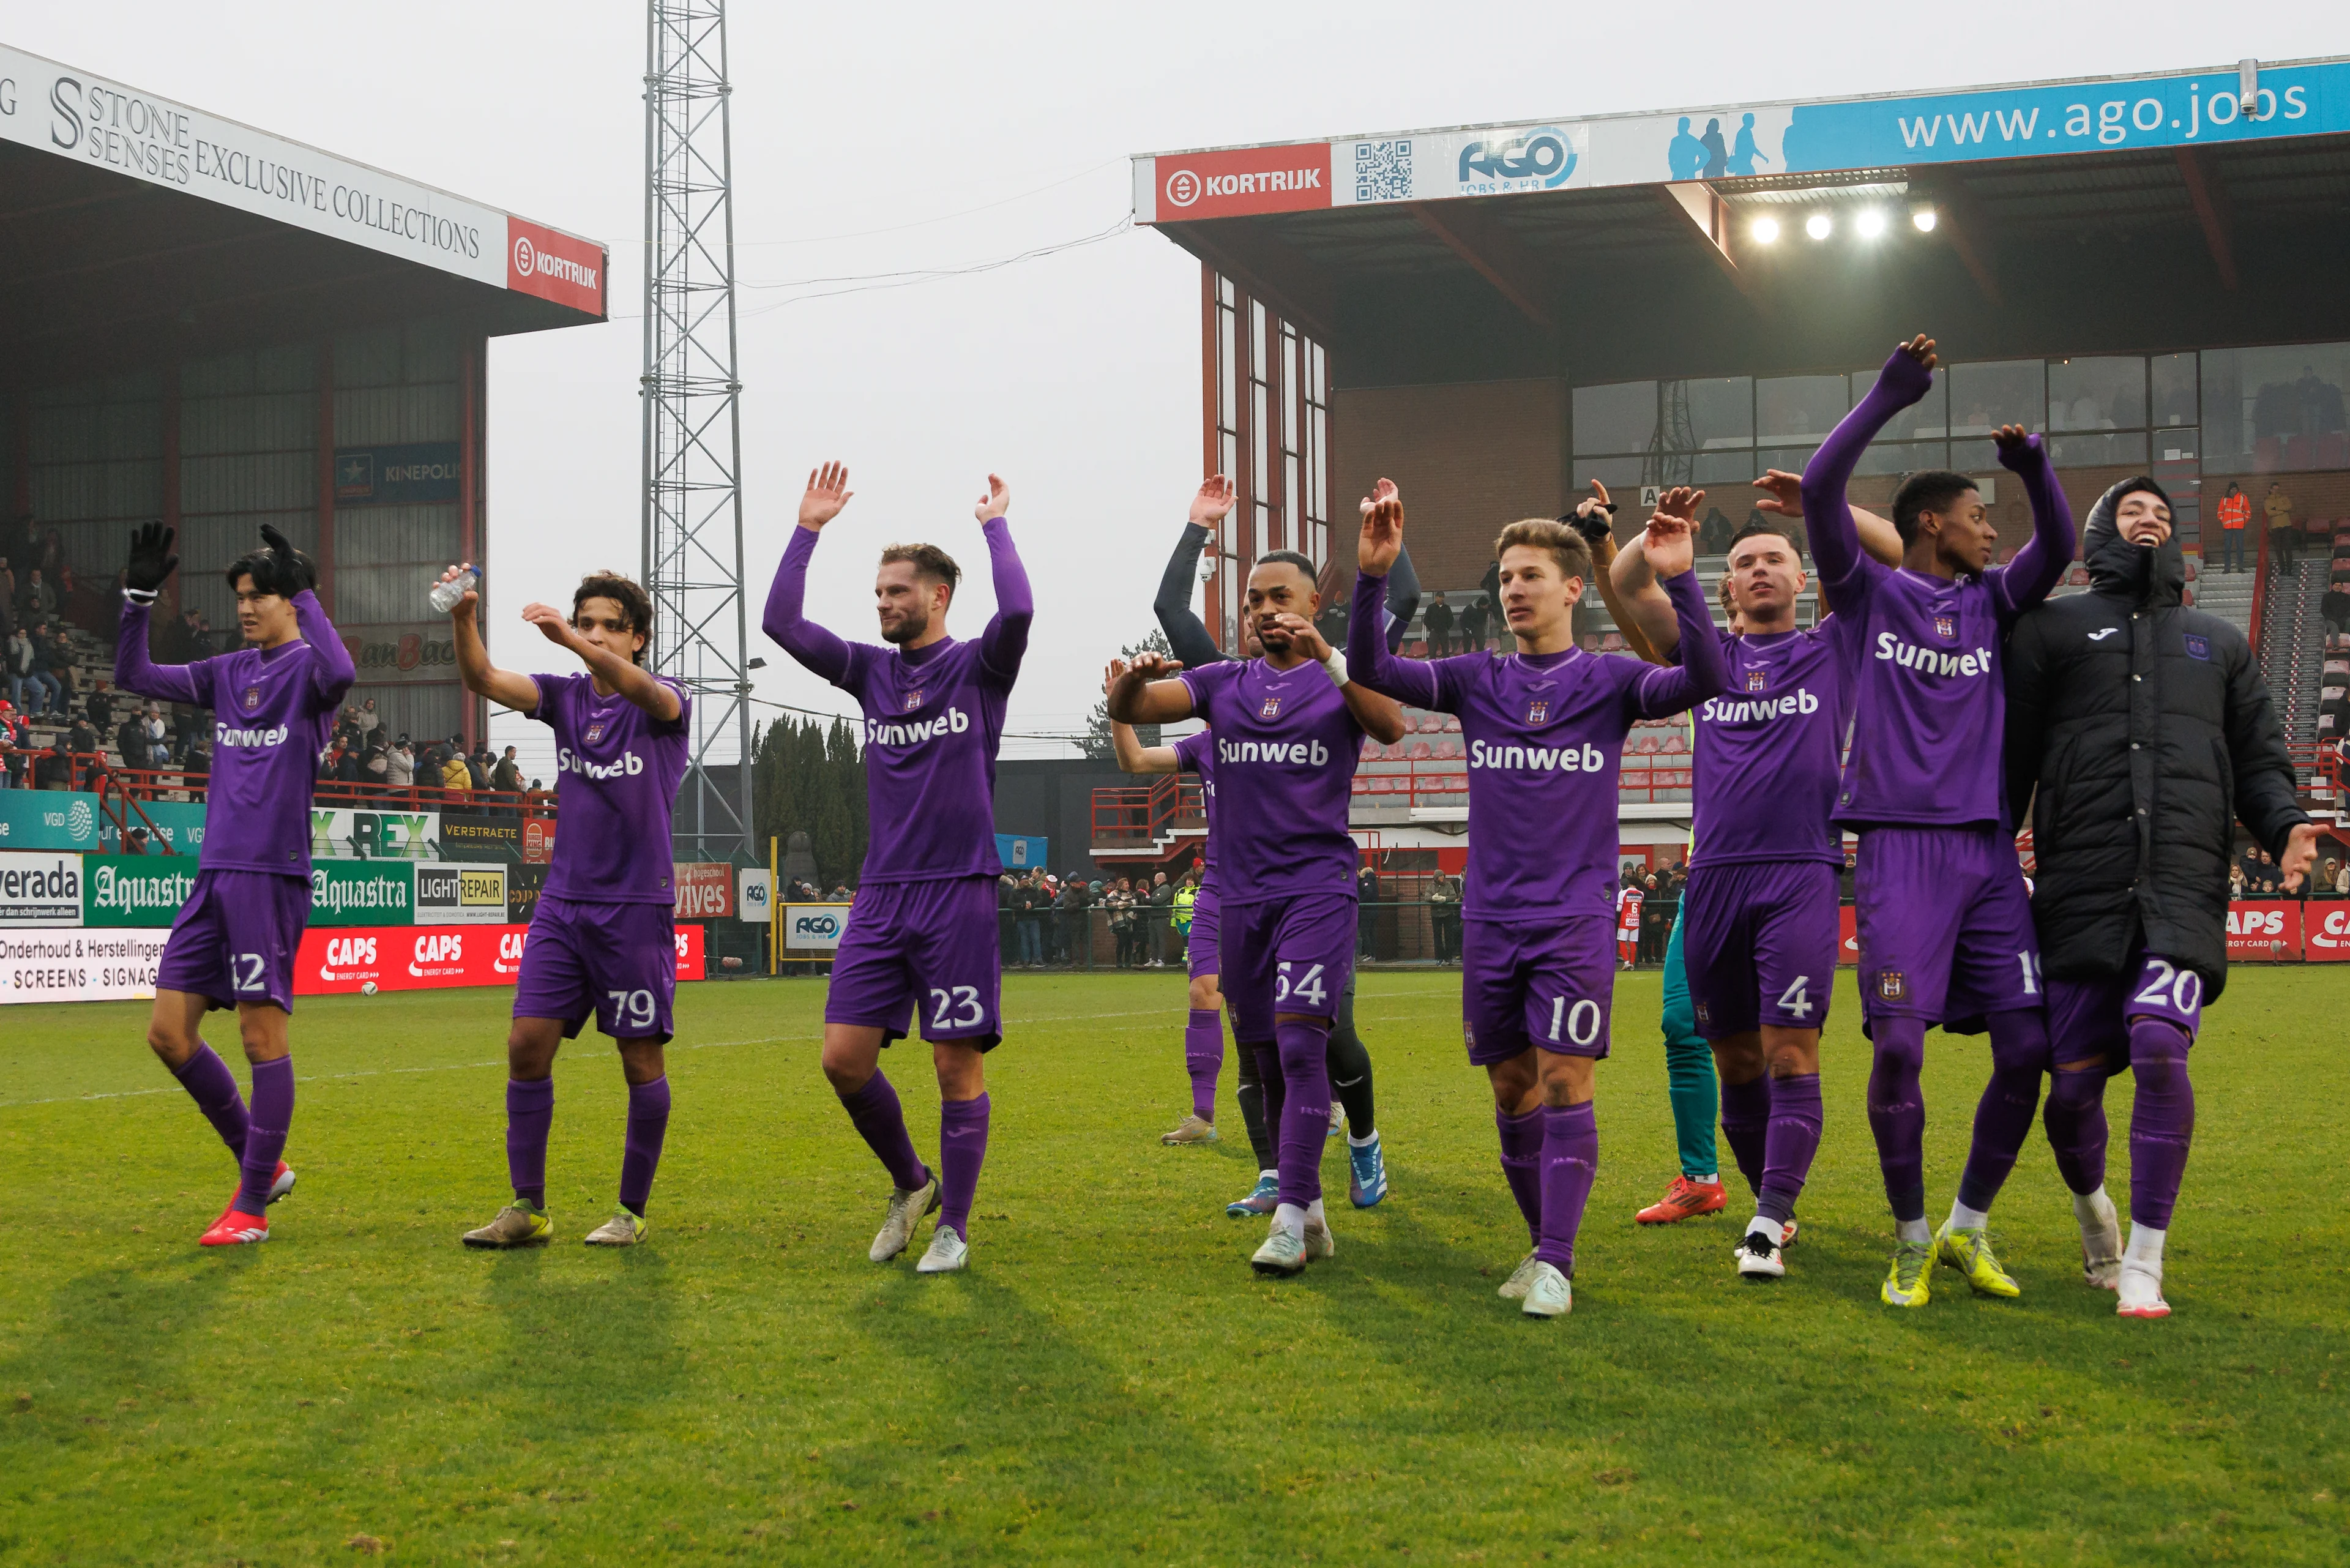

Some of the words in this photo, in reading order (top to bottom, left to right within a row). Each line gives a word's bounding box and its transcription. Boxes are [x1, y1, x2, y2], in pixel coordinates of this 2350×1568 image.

[89, 86, 190, 149] STONE
[89, 126, 190, 184] SENSES
[1459, 136, 1564, 182] AGO
[1207, 168, 1321, 196] KORTRIJK
[1460, 183, 1495, 196] JOBS
[1520, 180, 1539, 191] HR
[195, 139, 327, 212] EXCLUSIVE
[333, 185, 479, 259] COLLECTIONS
[537, 251, 597, 289] KORTRIJK
[1644, 489, 1657, 504] A
[1702, 688, 1818, 722] Sunweb
[868, 707, 969, 745] Sunweb
[559, 747, 643, 779] Suweb
[1218, 737, 1329, 766] Sunweb
[1471, 739, 1604, 772] Sunweb
[43, 812, 65, 826] VGD
[446, 824, 517, 838] VERSTRAETE
[354, 813, 430, 857] REX
[421, 878, 460, 898] LIGHT
[460, 879, 499, 898] REPAIR
[693, 867, 724, 880] hogeschool
[311, 869, 407, 915] Aquastra
[509, 889, 533, 903] COUP
[674, 884, 725, 914] vives
[747, 886, 765, 902] AGO
[6, 907, 18, 916] dan
[20, 906, 56, 918] schrijnwerk
[57, 907, 76, 916] alleen
[1632, 903, 1638, 913] 6
[796, 917, 835, 933] AGO
[0, 939, 71, 959] Onderhoud
[75, 939, 83, 958] &
[327, 937, 376, 966] CAPS
[414, 935, 462, 962] CAPS
[14, 968, 86, 989] SCREENS
[2134, 960, 2201, 1015] 20
[608, 989, 656, 1028] 79
[931, 985, 984, 1029] 23
[1777, 976, 1813, 1018] 4
[1548, 996, 1600, 1045] 10
